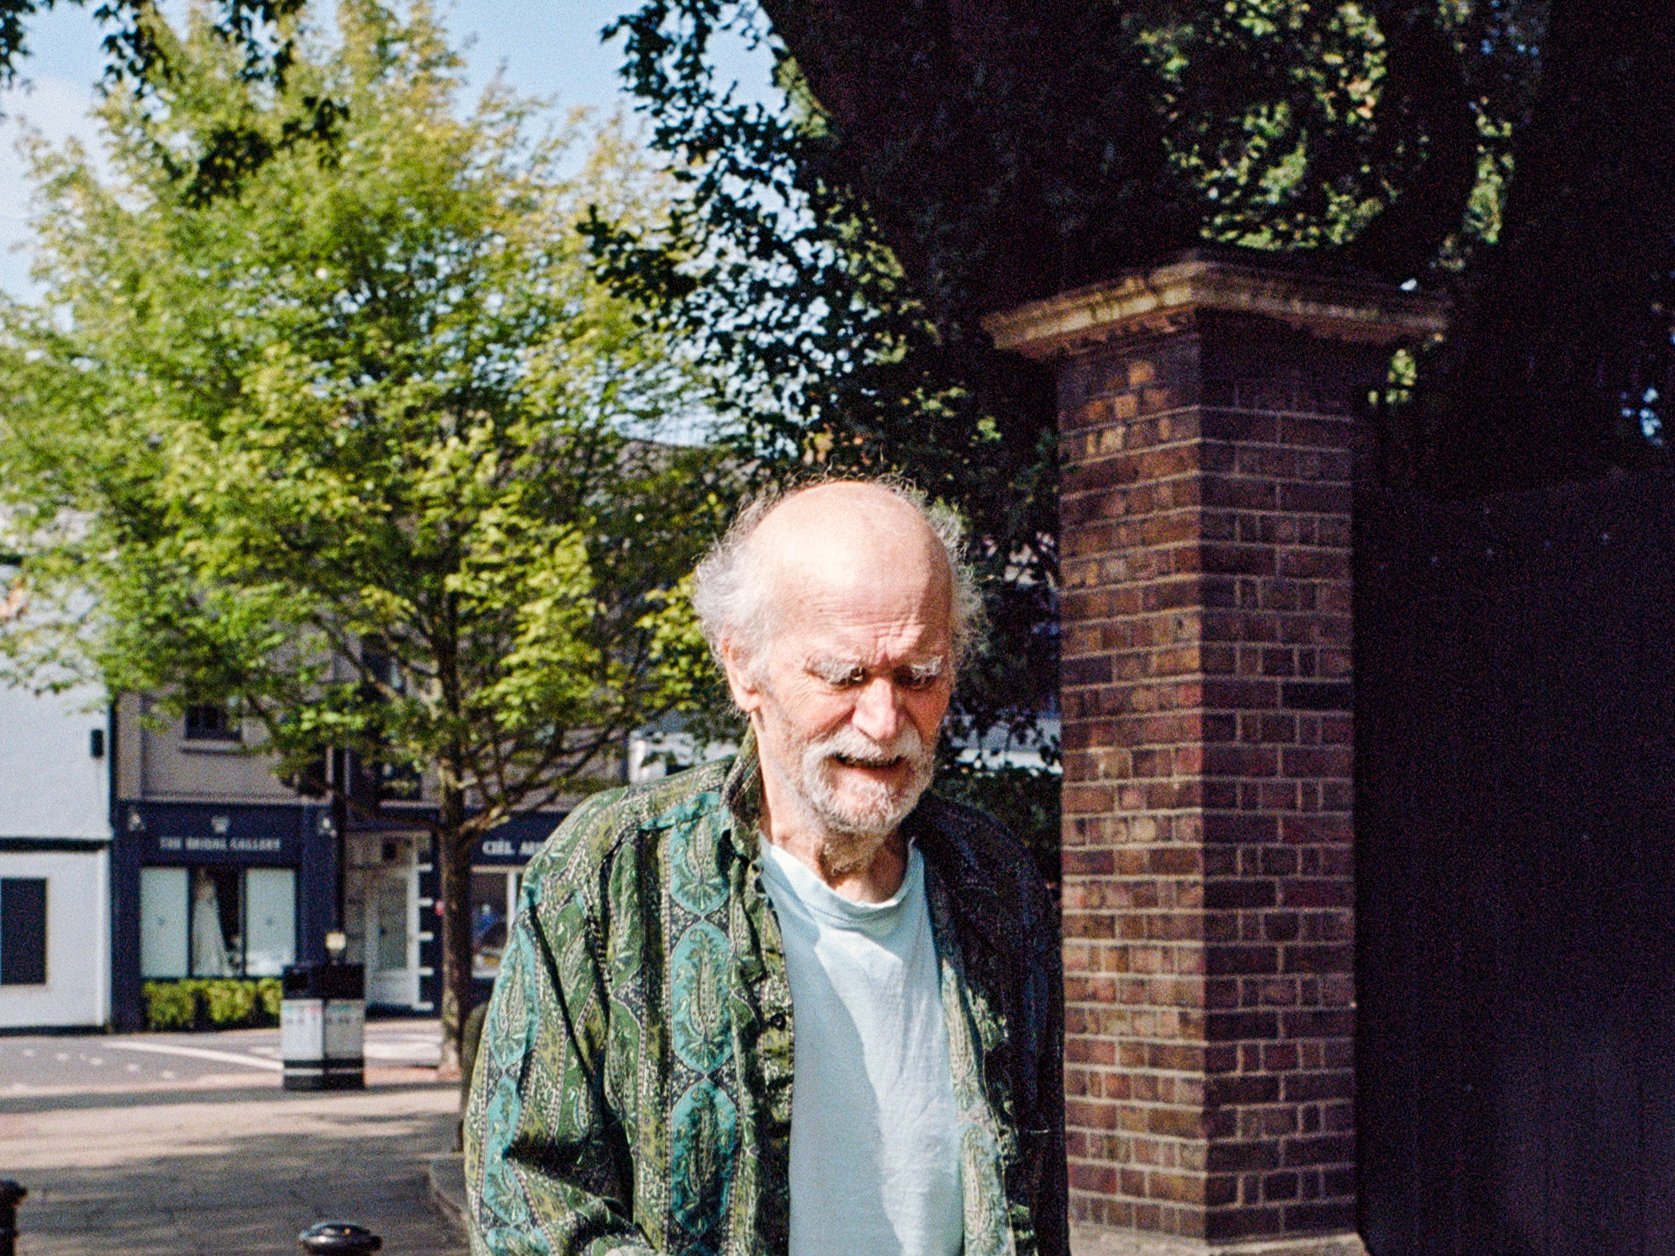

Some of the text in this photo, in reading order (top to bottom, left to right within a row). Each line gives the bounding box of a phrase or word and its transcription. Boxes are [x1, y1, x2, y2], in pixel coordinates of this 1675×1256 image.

[160, 837, 281, 851] THE BRIDAL GALLERY
